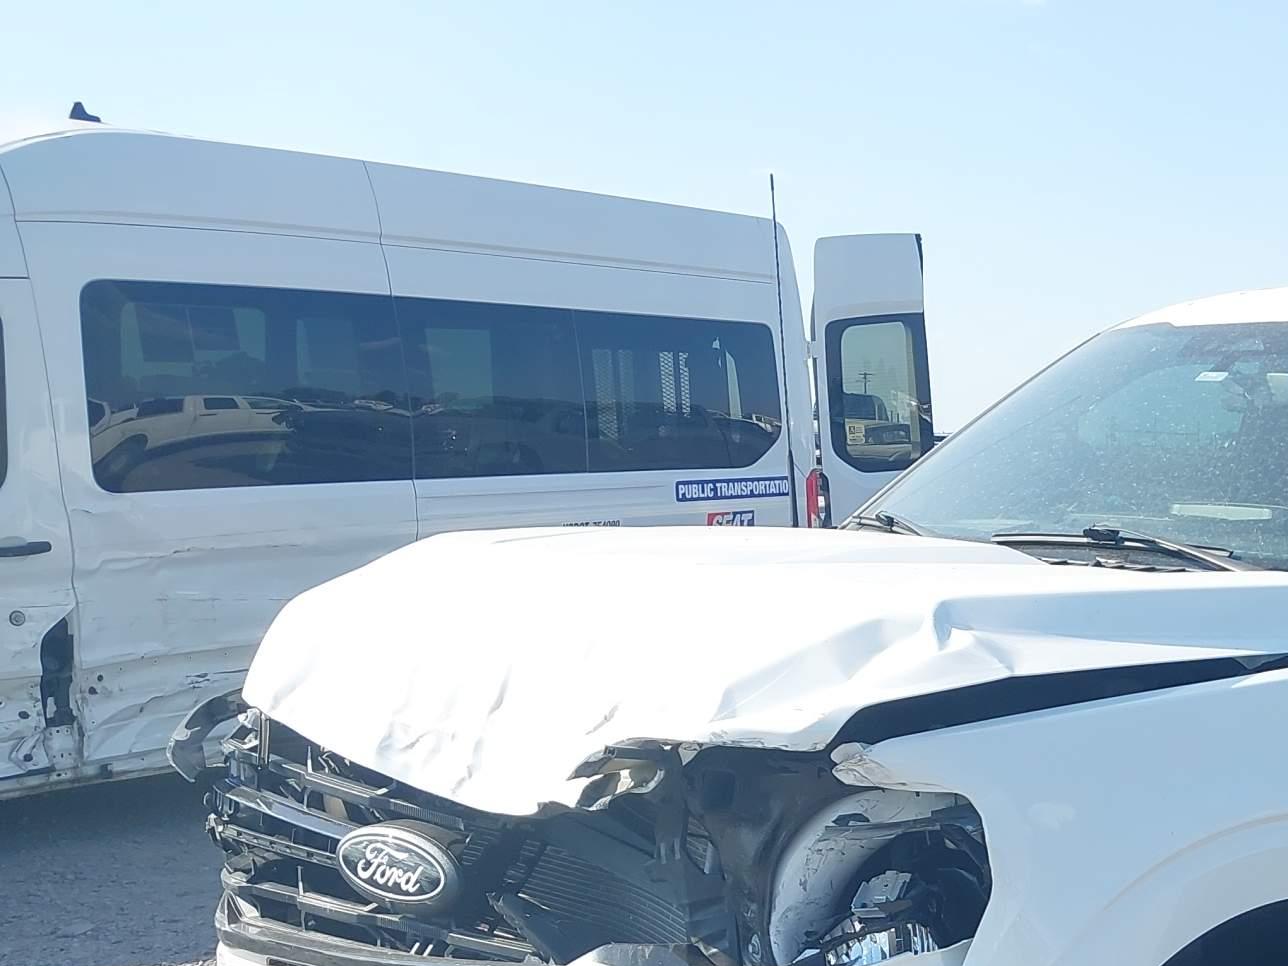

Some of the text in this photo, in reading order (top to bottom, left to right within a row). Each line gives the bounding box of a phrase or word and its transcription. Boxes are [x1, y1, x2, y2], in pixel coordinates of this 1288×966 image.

[678, 479, 789, 499] PUBLIC TRANSPORTATIO
[713, 513, 753, 526] SEAT
[357, 842, 424, 893] Ford
